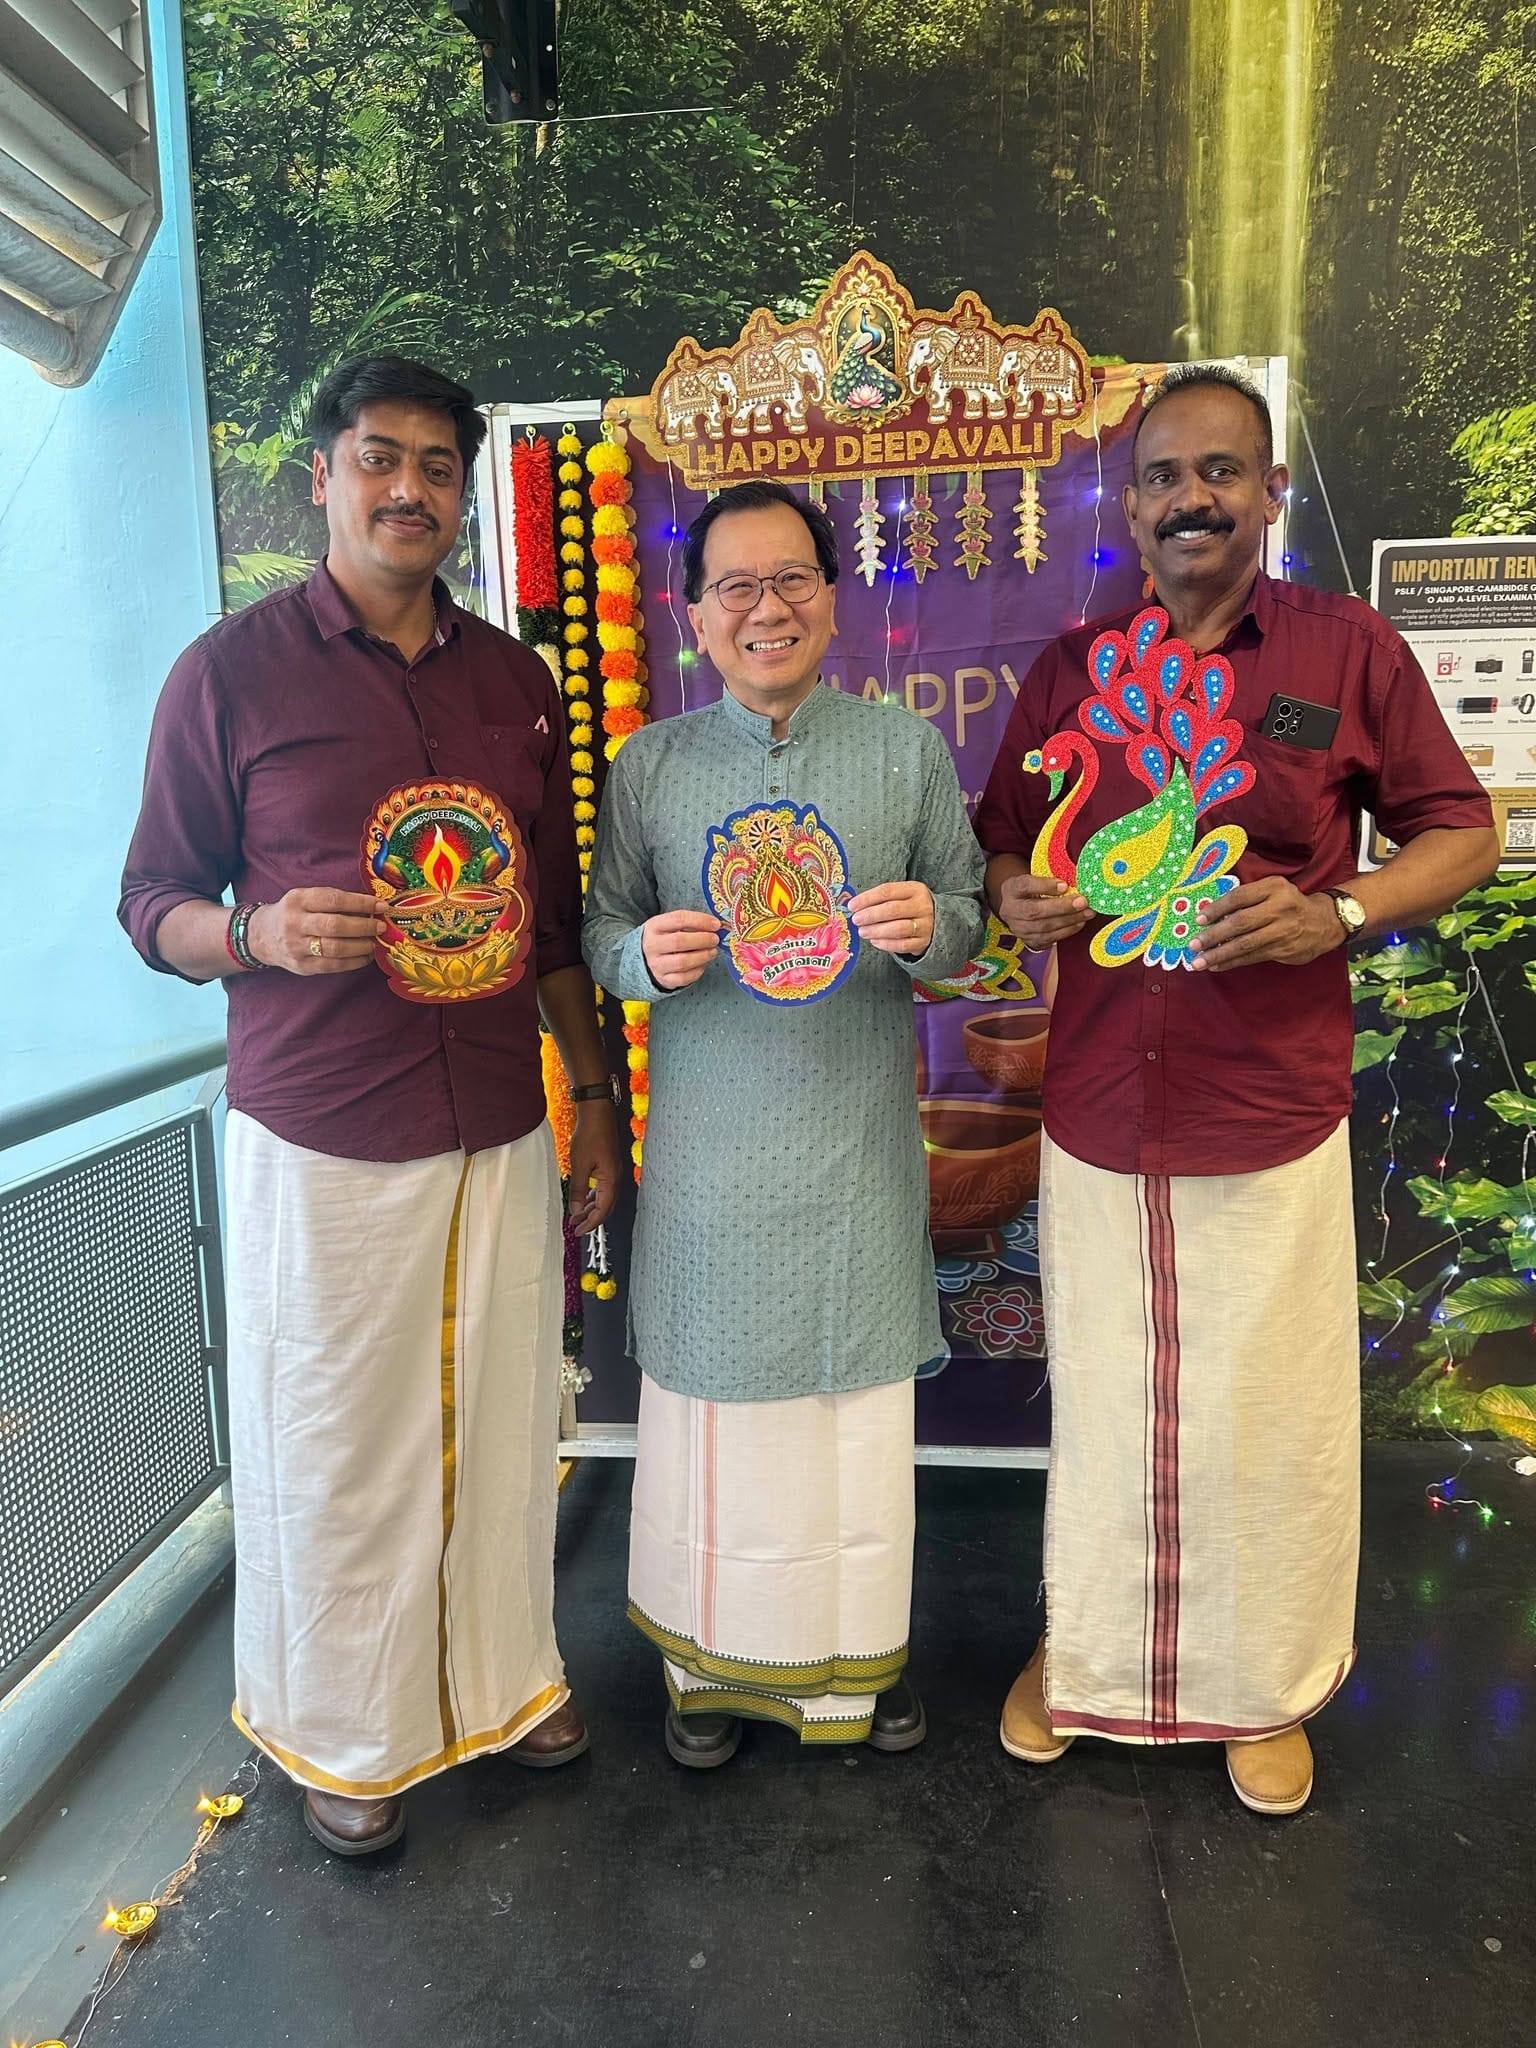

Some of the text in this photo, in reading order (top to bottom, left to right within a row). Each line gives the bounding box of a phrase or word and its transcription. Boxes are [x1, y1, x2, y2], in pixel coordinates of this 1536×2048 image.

[697, 422, 1043, 475] HAPPY DEEPAVALI
[1391, 557, 1500, 583] IMPORTANT
[1394, 587, 1416, 596] PSLE
[1424, 584, 1529, 594] SINGAPORE-CAMBRIDGE
[1427, 596, 1435, 604] O
[1457, 595, 1491, 603] A-LEVEL
[400, 810, 481, 836] HAPPY DEEPAVALI
[762, 955, 833, 985] தீபாவளி
